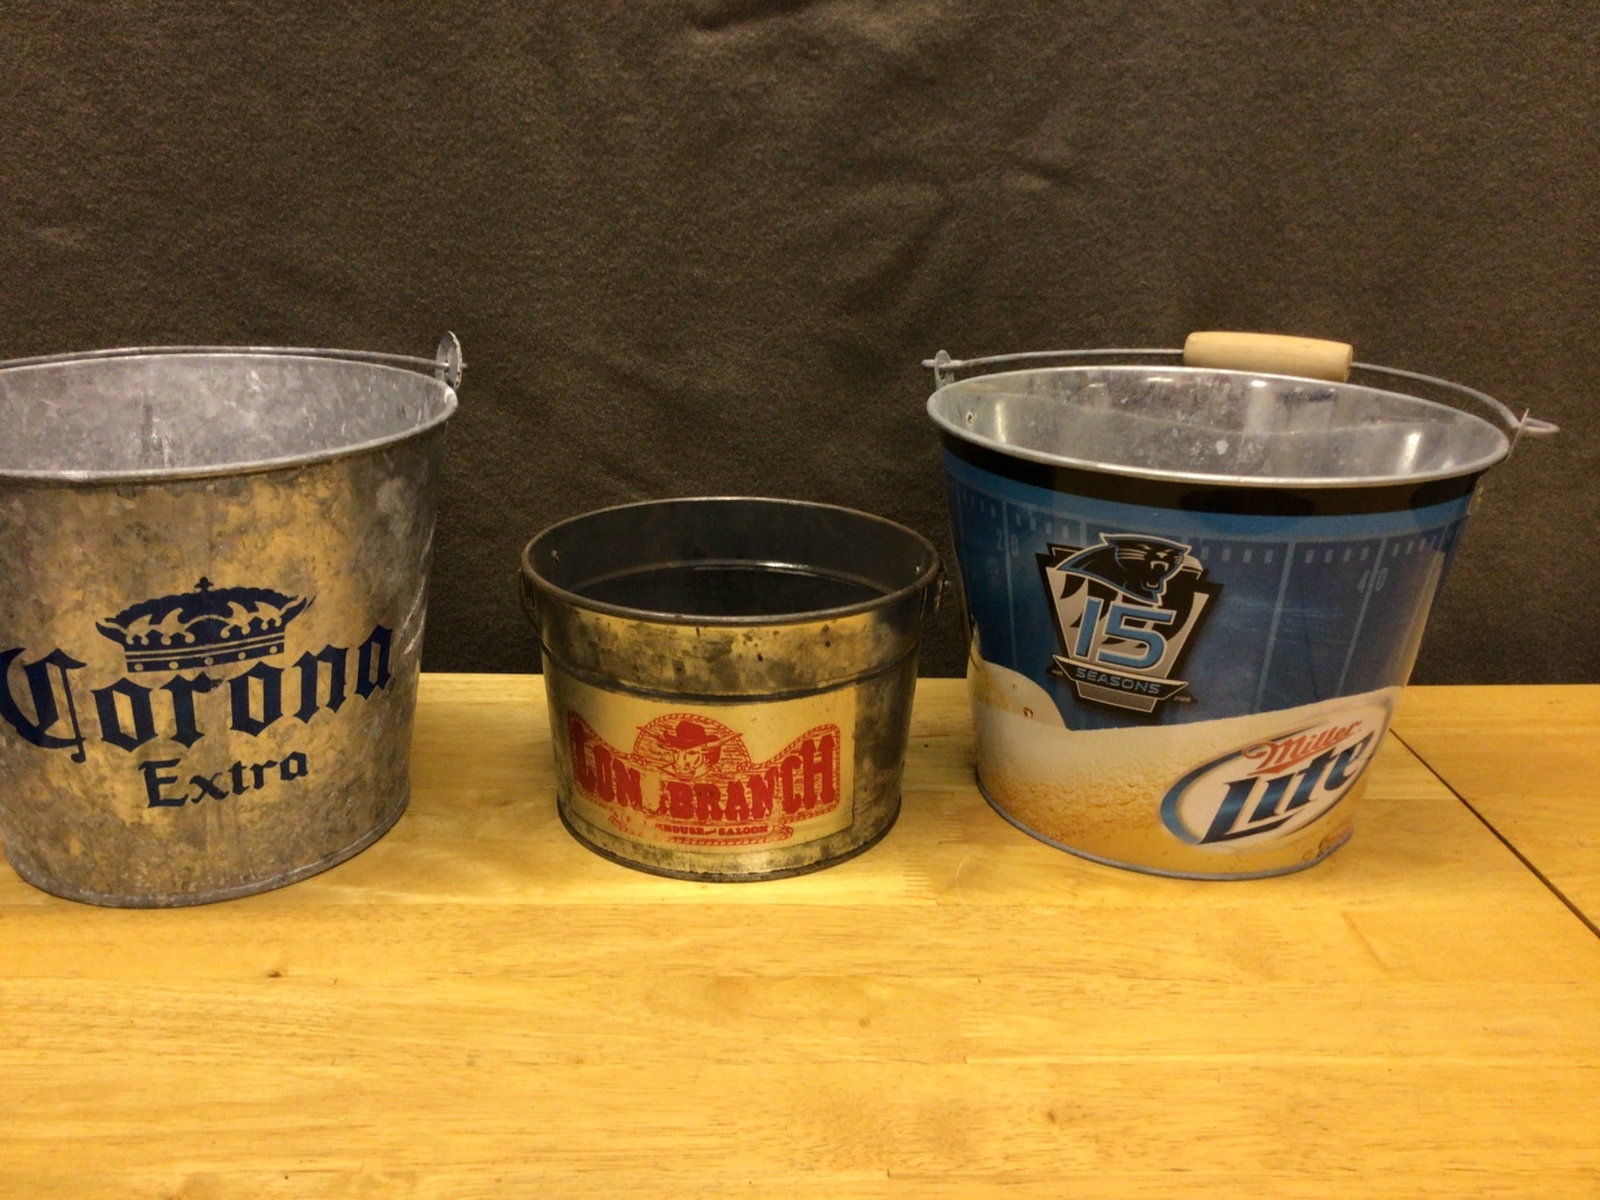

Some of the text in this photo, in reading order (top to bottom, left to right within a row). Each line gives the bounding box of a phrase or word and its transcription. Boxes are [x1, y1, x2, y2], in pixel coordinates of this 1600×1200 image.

[1357, 567, 1389, 593] 40
[1073, 595, 1177, 672] 15
[0, 624, 395, 763] Corona
[1076, 667, 1161, 695] SEASONS
[138, 751, 309, 809] Extra
[667, 733, 836, 821] BRANCH
[1242, 720, 1363, 777] Miller
[1199, 731, 1375, 845] Lite
